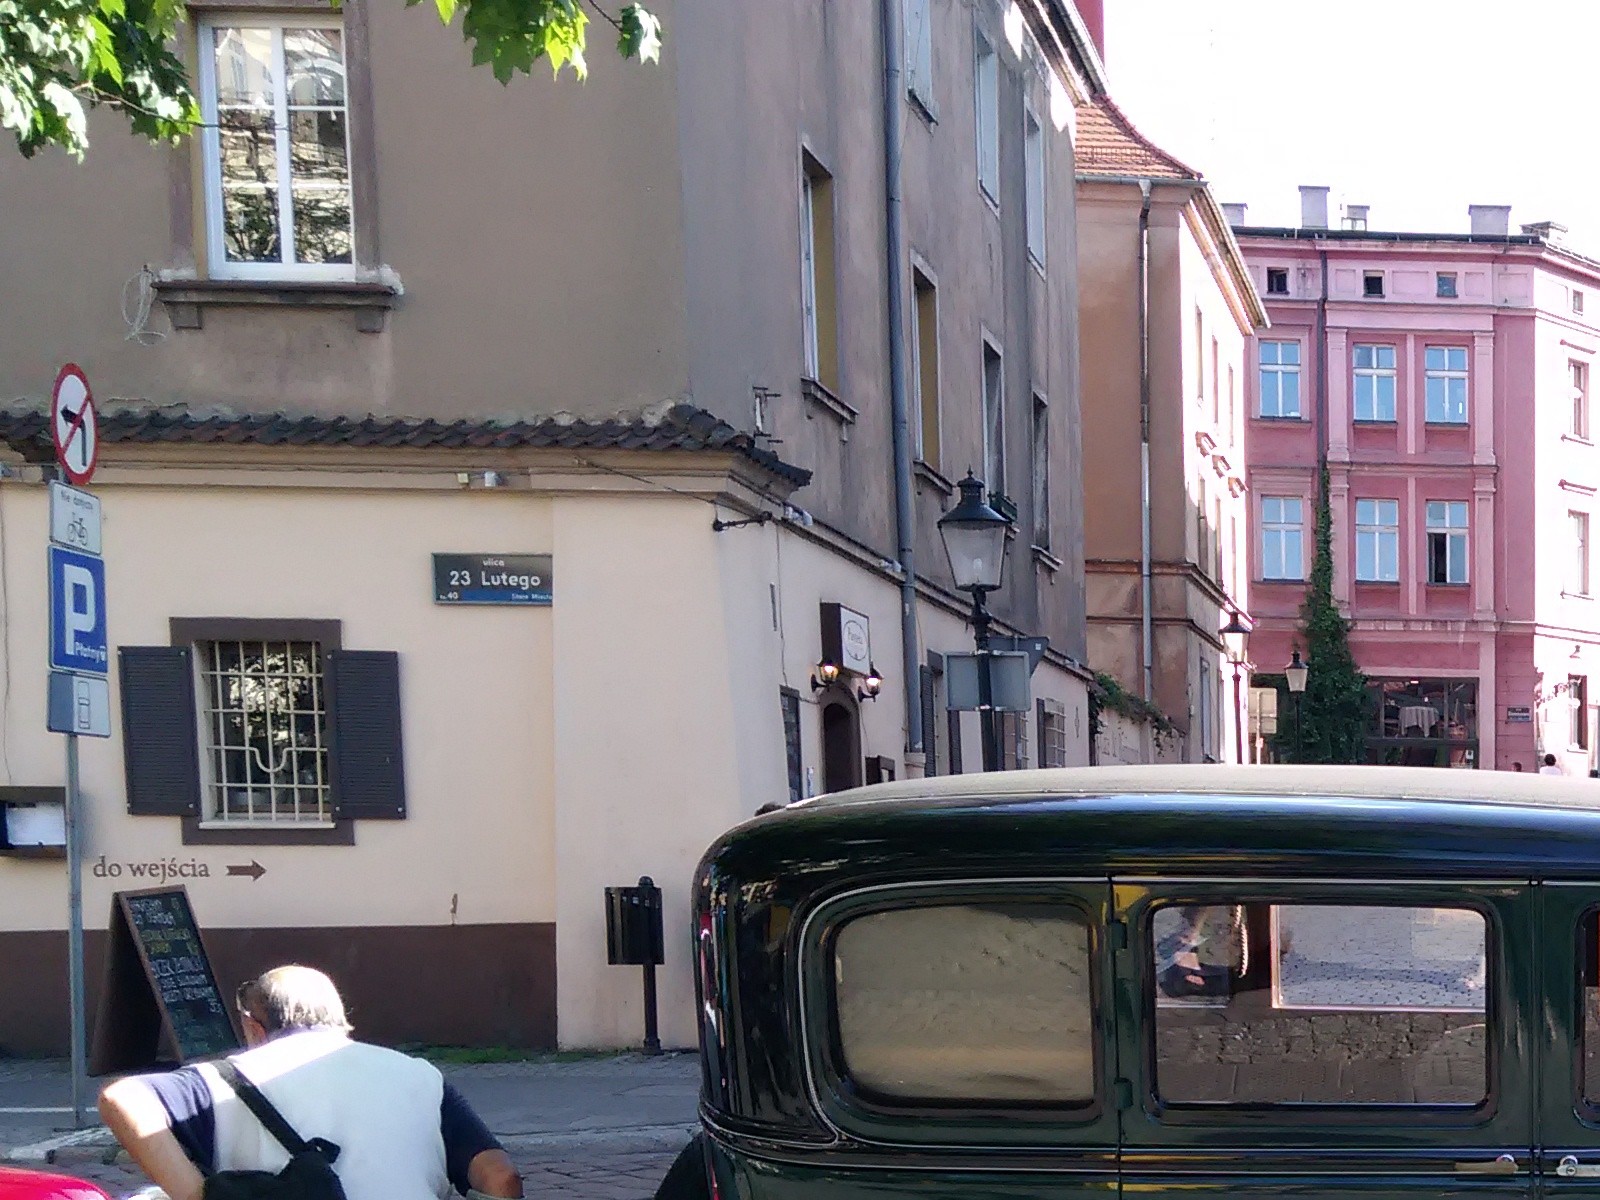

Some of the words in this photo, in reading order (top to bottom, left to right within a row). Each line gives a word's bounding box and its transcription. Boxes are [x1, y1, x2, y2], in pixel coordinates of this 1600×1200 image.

[482, 558, 505, 567] ulica
[450, 570, 471, 586] 23
[481, 571, 541, 591] Lutego
[64, 563, 96, 656] P
[93, 856, 123, 878] do
[127, 857, 210, 884] wejścia
